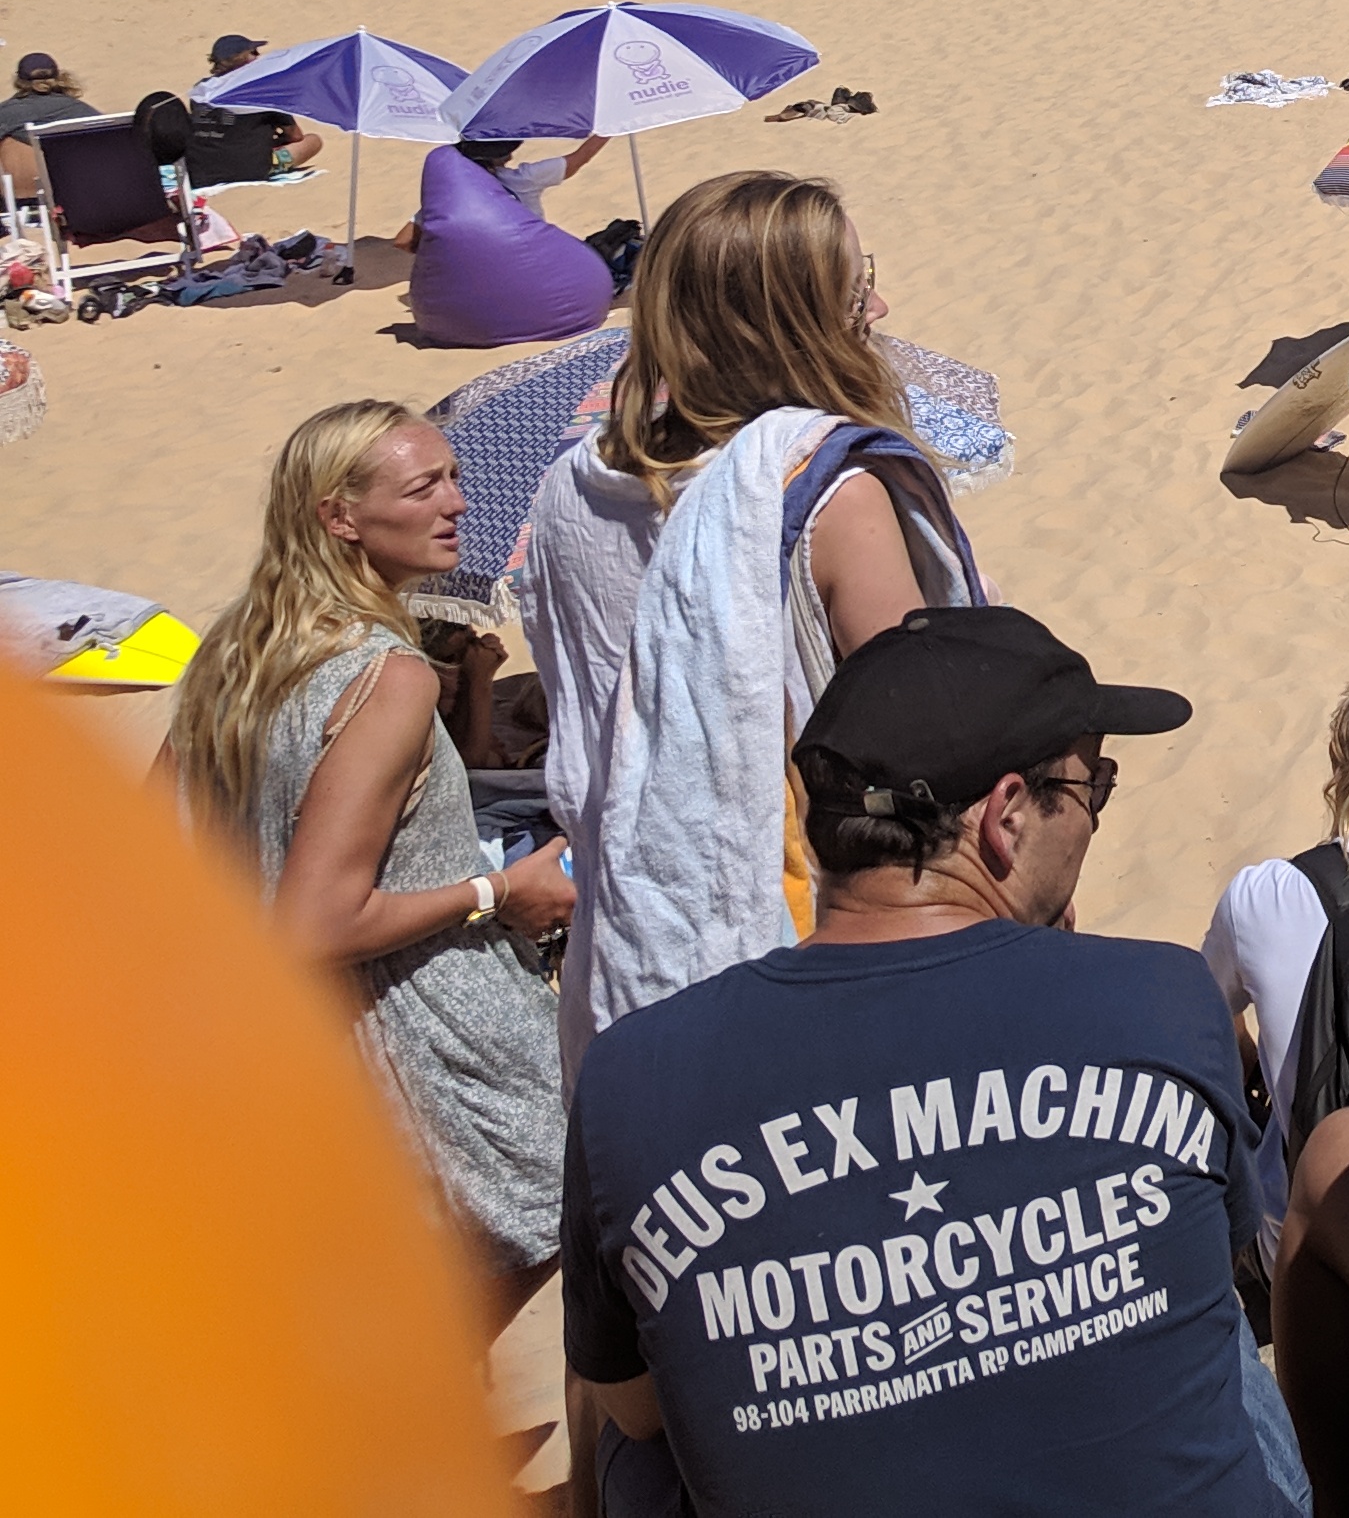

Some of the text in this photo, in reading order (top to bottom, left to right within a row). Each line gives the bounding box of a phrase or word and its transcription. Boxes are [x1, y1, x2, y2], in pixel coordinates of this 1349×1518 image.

[628, 80, 690, 101] nudie
[620, 1064, 1216, 1313] DEUS EX MACHINA
[696, 1163, 1172, 1342] MOTORCYCLES
[732, 1402, 810, 1433] 98-104
[815, 1357, 976, 1422] PARRAMATTA
[1013, 1287, 1169, 1366] CAMPERDOWN
[749, 1242, 1145, 1393] PARTS AND SERVICE
